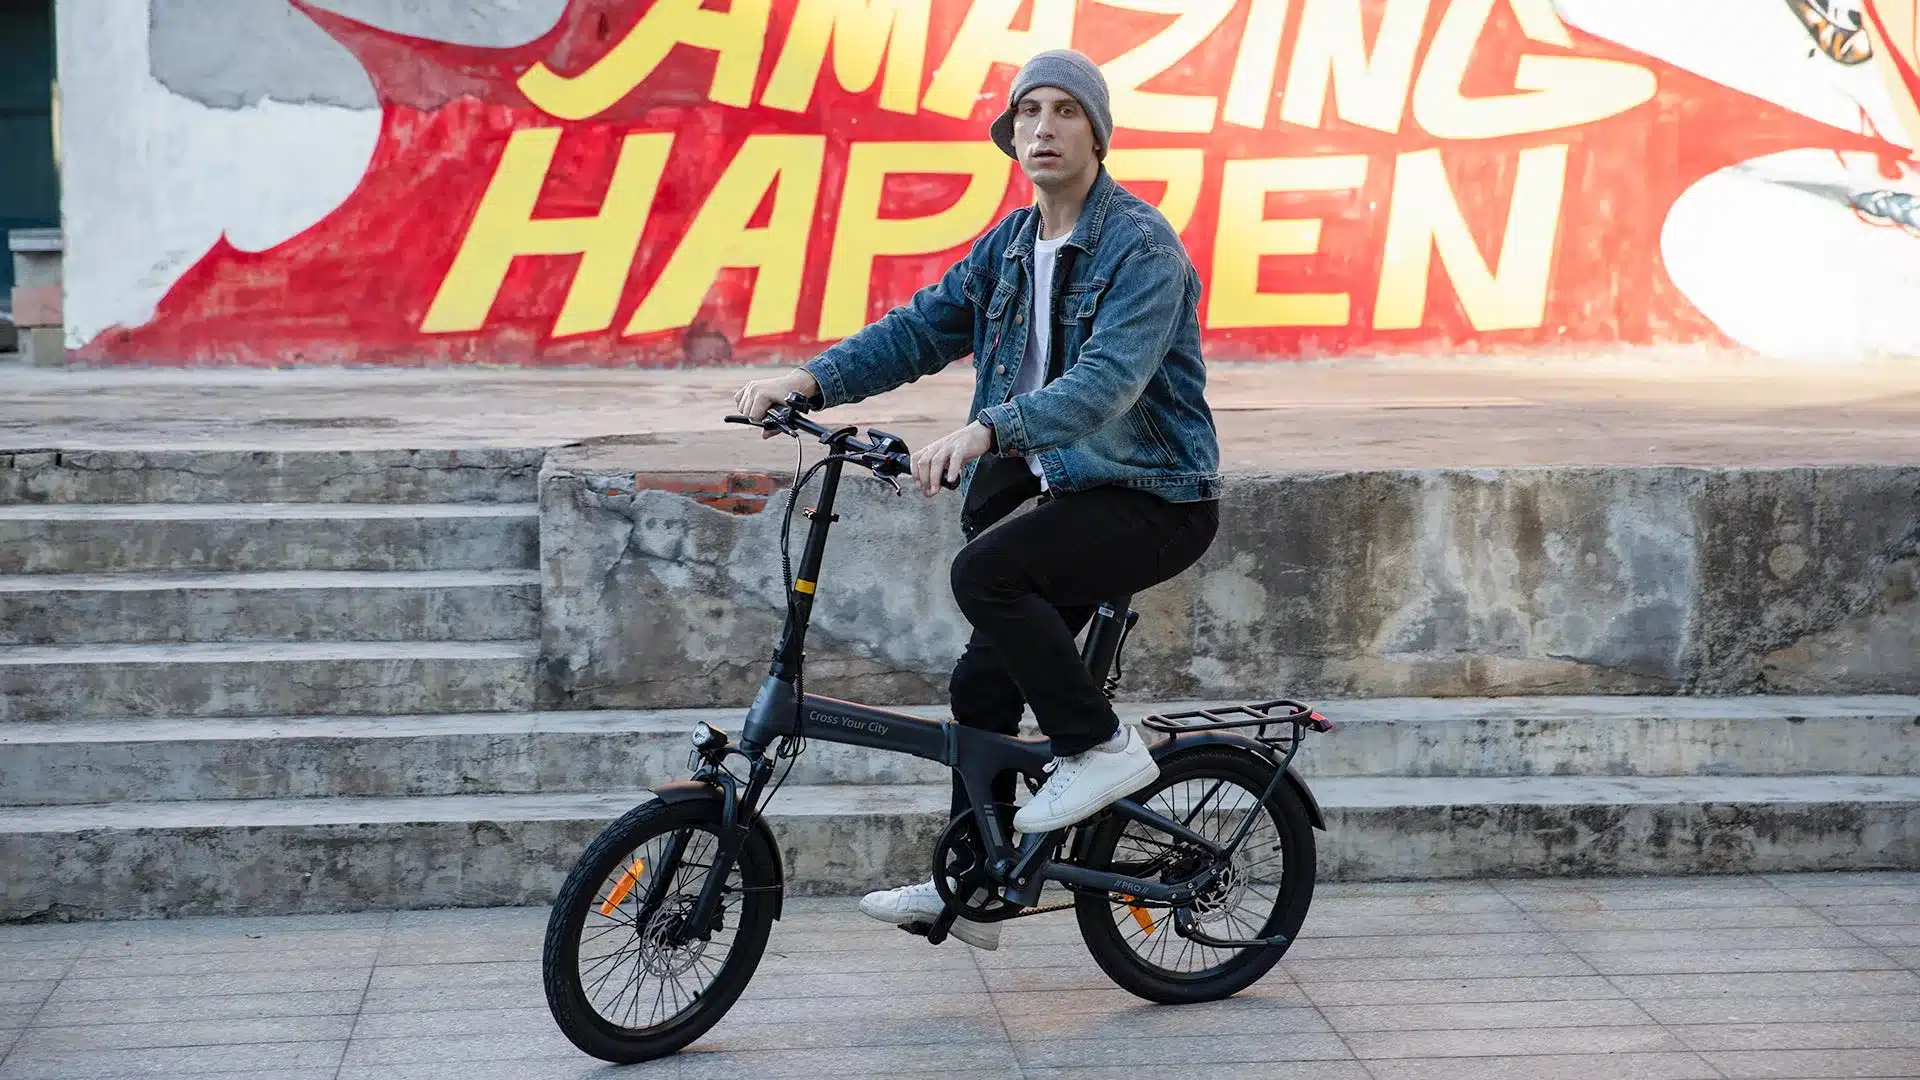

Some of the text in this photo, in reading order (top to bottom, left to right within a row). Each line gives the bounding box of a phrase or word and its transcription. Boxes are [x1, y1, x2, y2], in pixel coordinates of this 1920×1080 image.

[809, 711, 888, 735] Cross Your City
